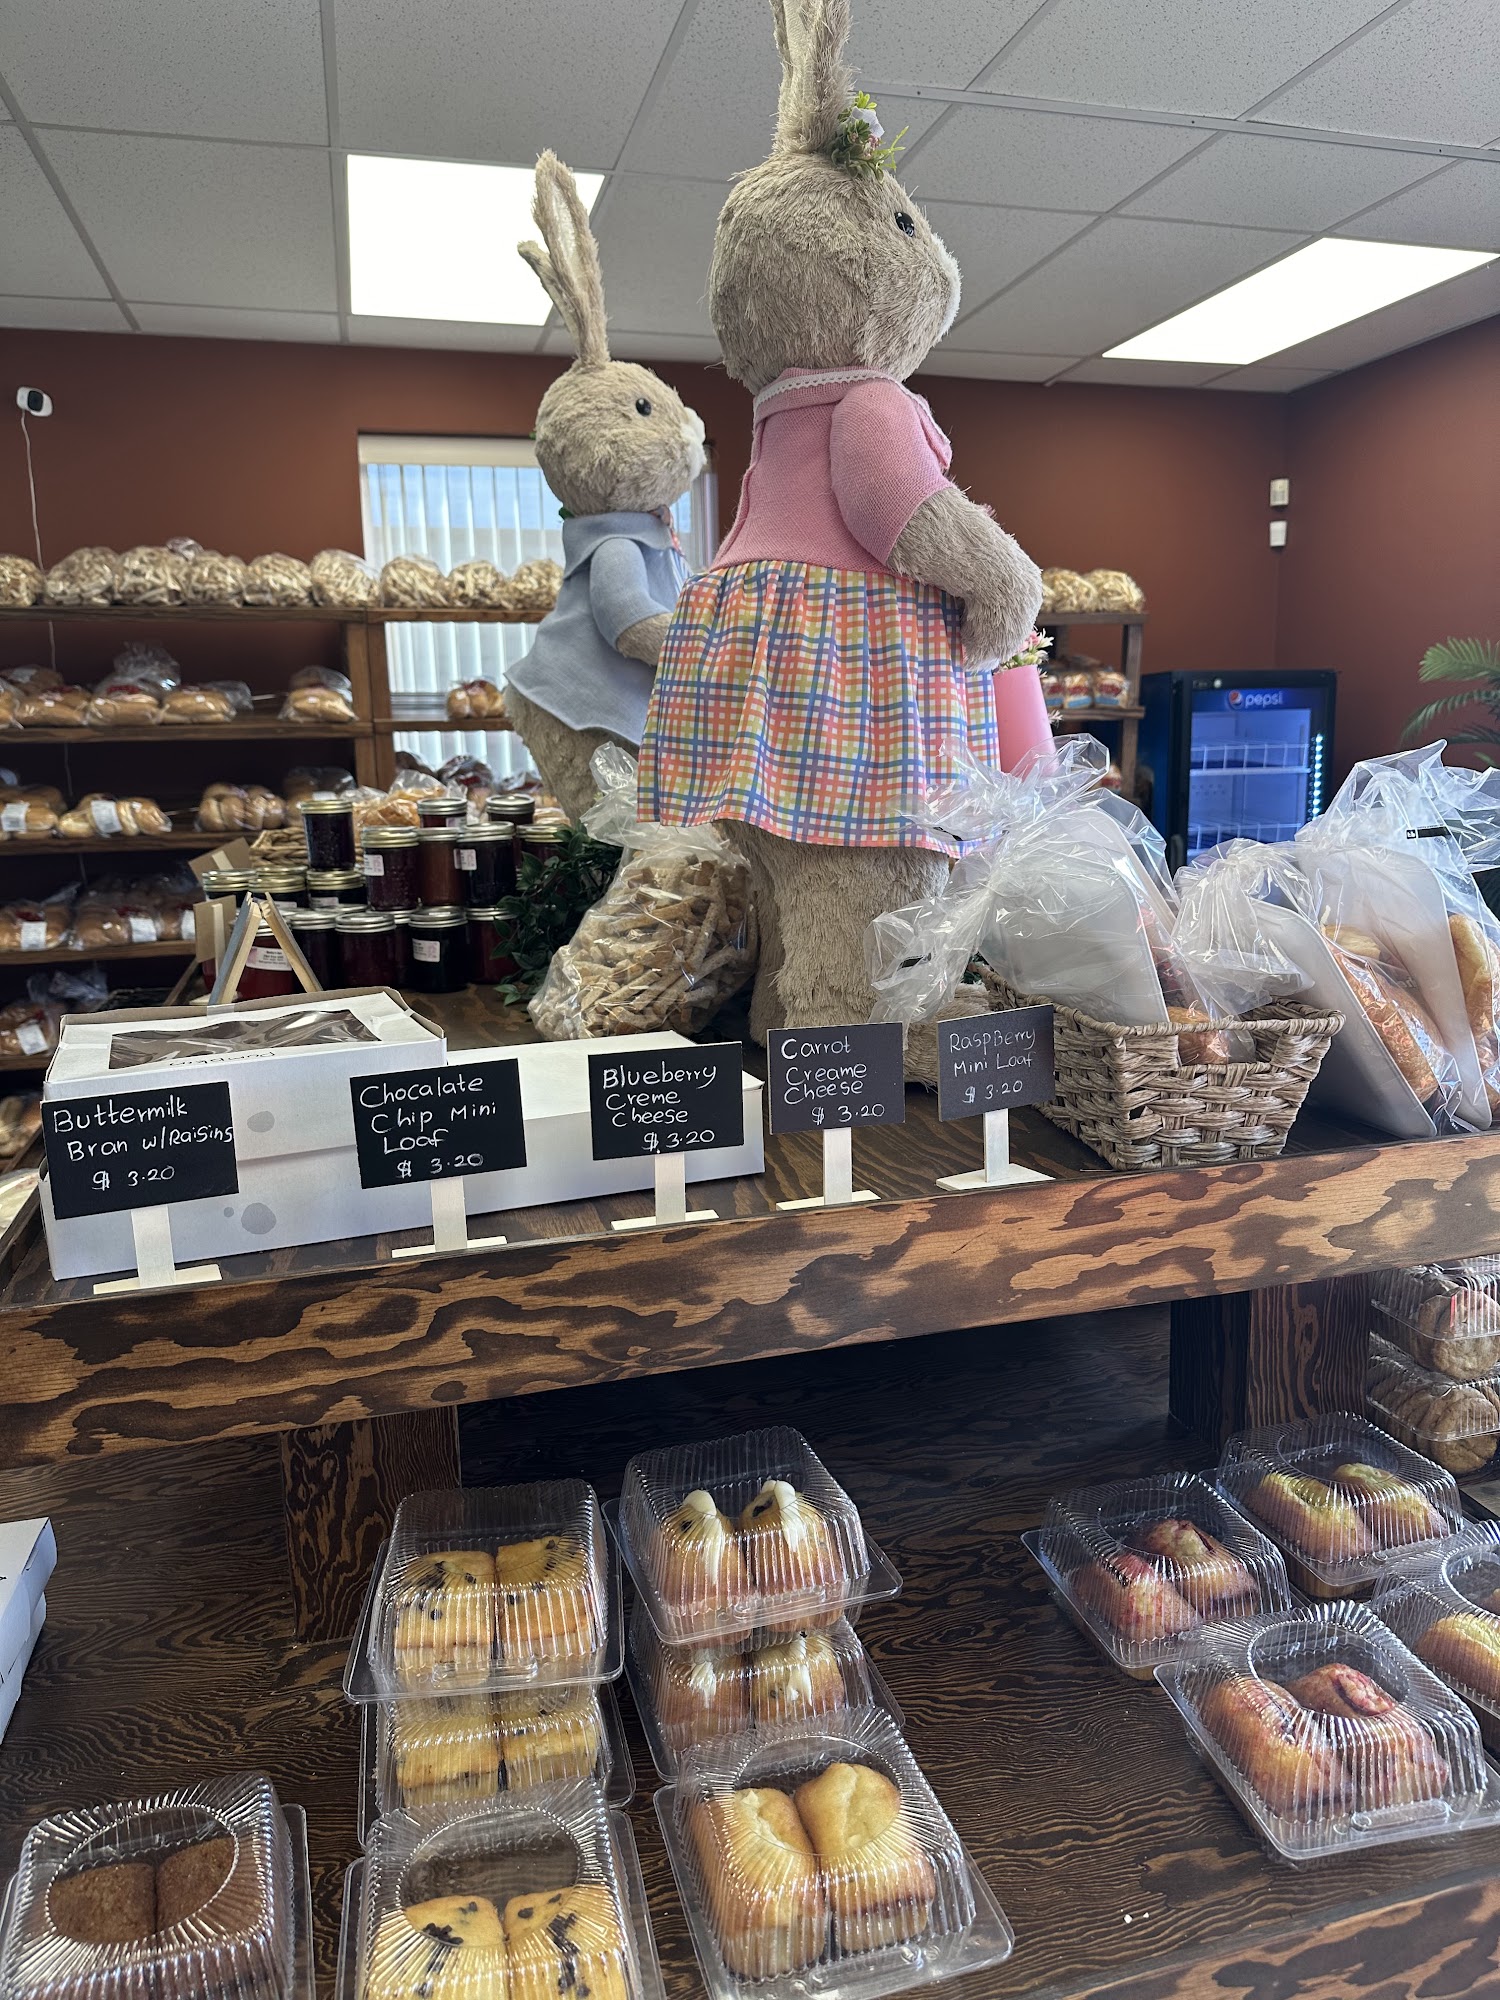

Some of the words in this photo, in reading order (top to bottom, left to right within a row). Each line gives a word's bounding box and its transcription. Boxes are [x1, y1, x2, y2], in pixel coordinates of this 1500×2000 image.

[1245, 691, 1283, 709] pepsi
[781, 1035, 852, 1060] Carrot
[603, 1060, 717, 1090] Blueberry
[785, 1063, 868, 1086] Creame
[954, 1057, 988, 1077] Mini
[996, 1051, 1036, 1070] Loaf
[359, 1073, 484, 1108] Chocalate
[605, 1091, 681, 1111] Creme
[784, 1080, 863, 1105] Cheese
[53, 1094, 188, 1134] Buttermilk
[371, 1107, 433, 1134] Chip
[450, 1101, 496, 1122] Mini
[612, 1107, 688, 1128] Cheese
[67, 1139, 128, 1162] Bran
[384, 1128, 449, 1155] Loaf
